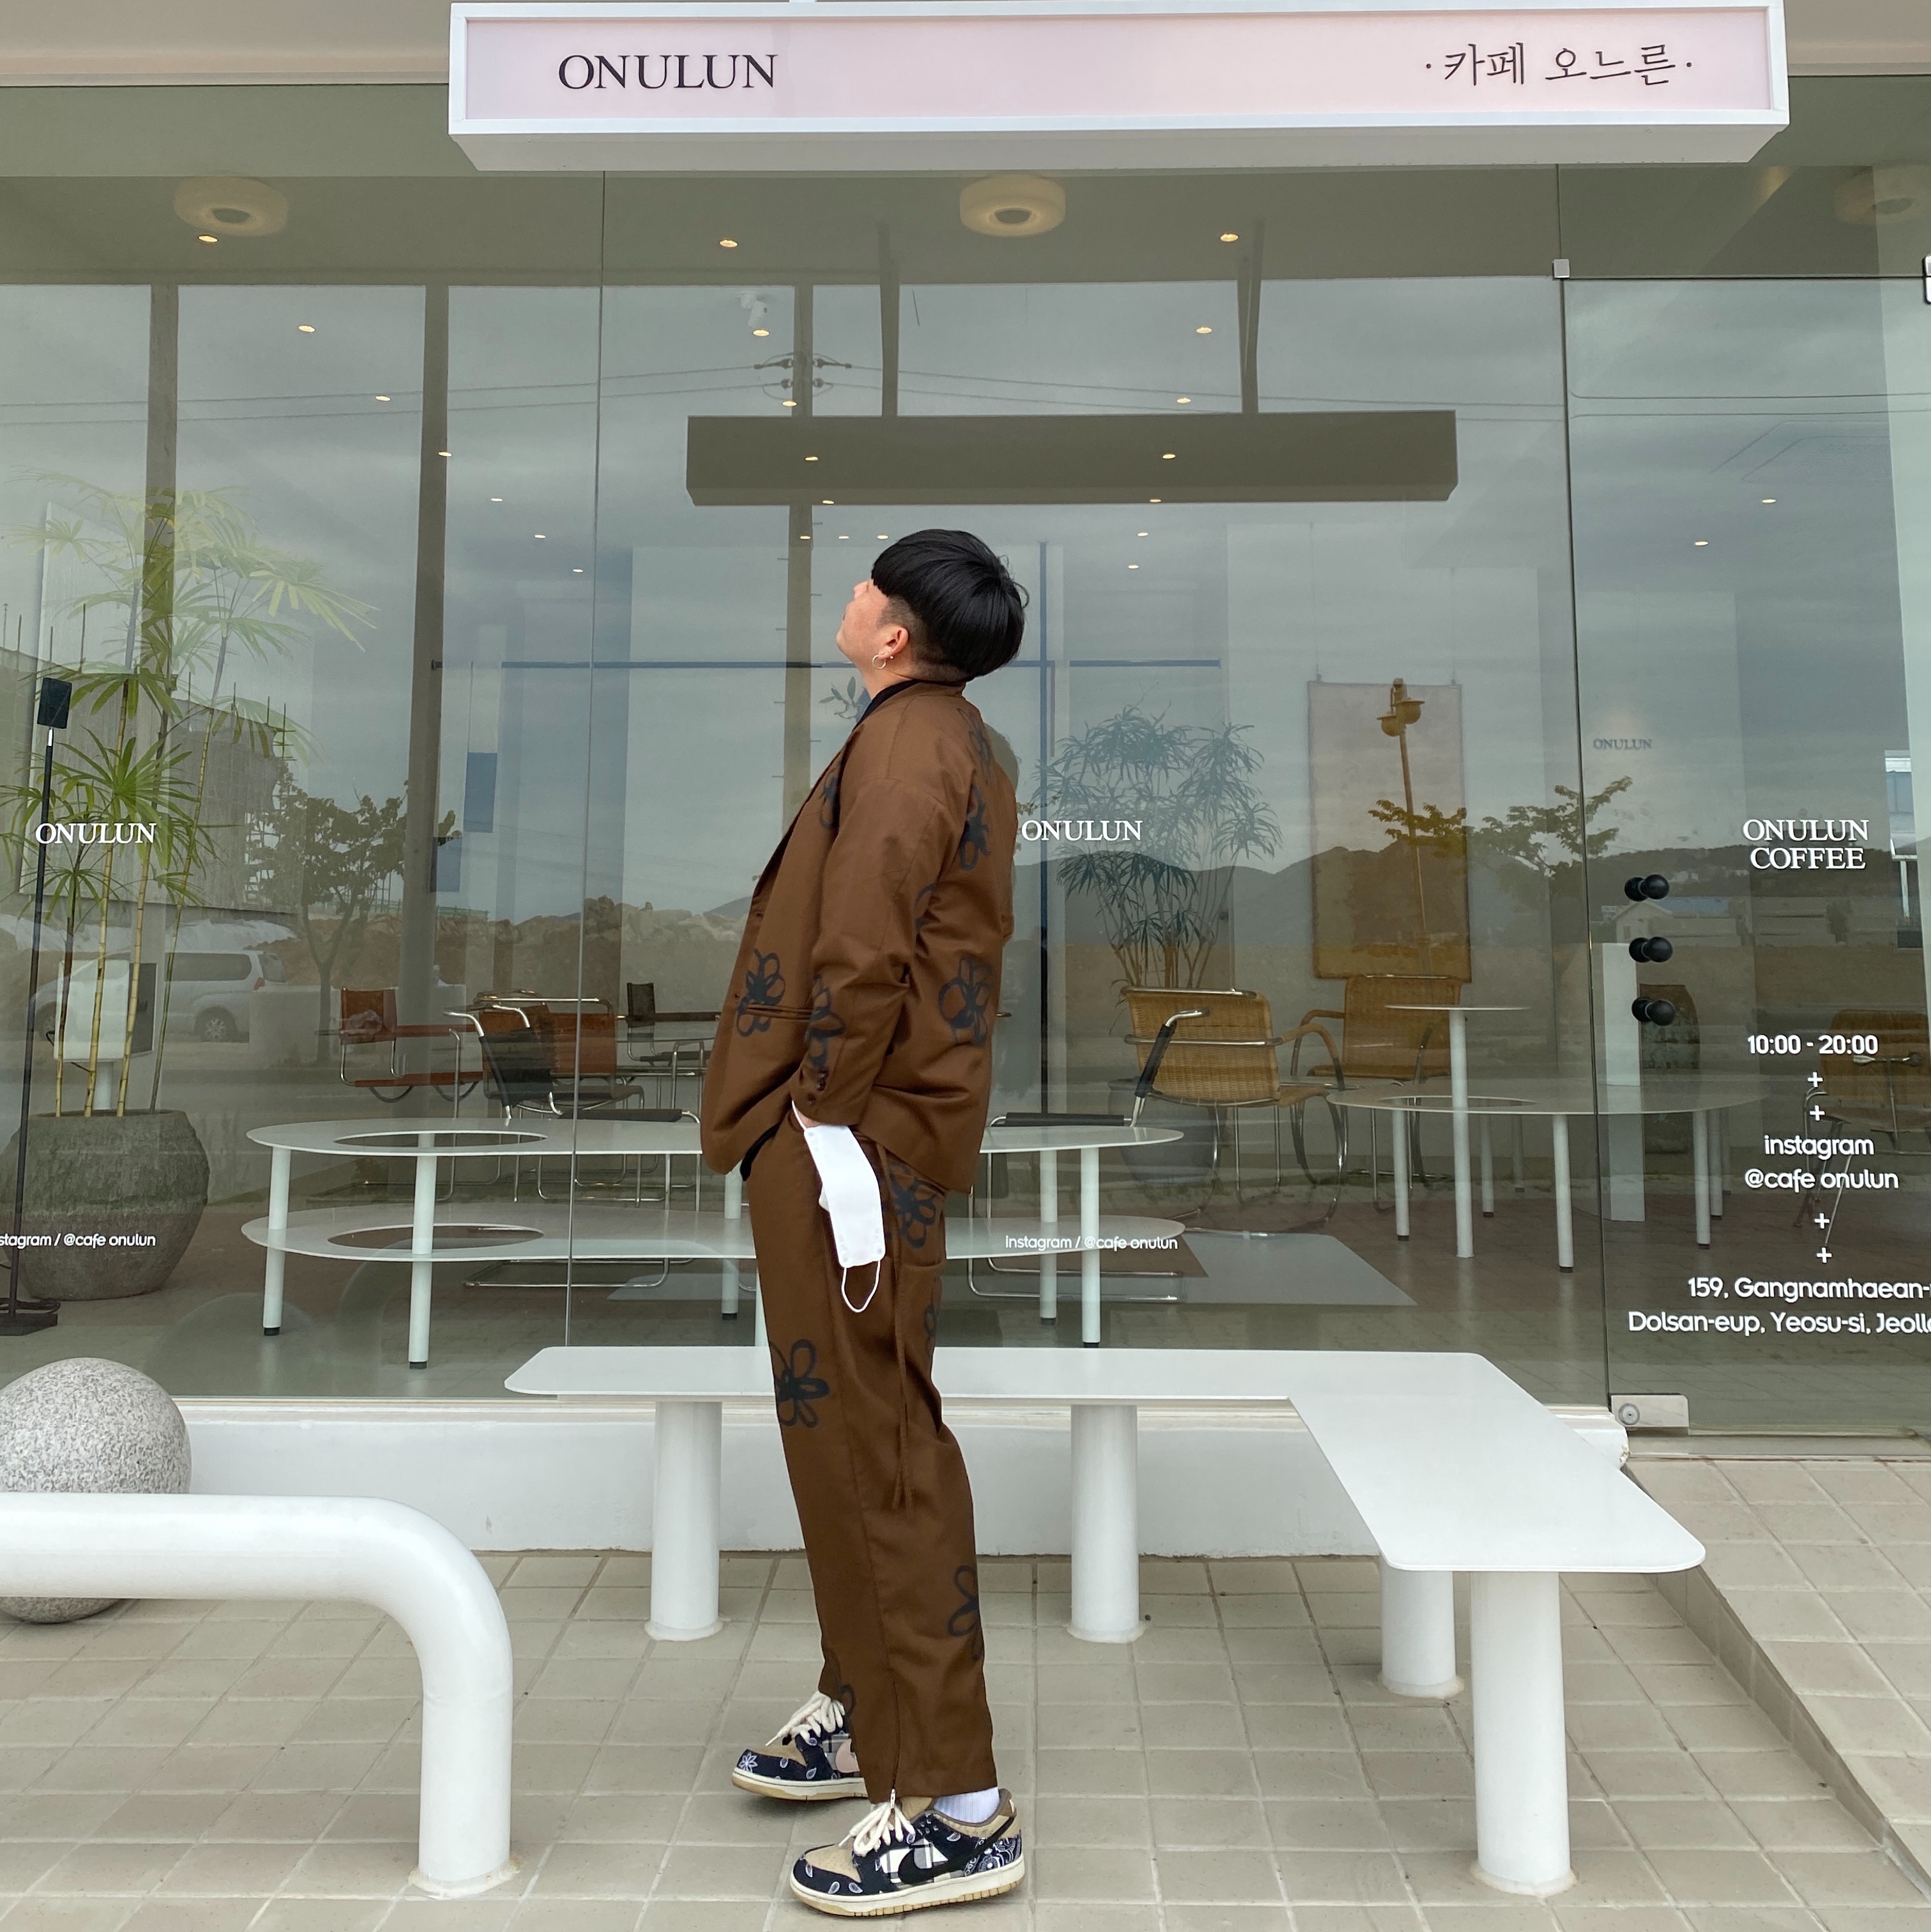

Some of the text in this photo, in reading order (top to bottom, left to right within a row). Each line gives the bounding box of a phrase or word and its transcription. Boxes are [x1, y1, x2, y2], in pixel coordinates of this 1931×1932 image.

[558, 54, 778, 89] ONULUN
[1593, 738, 1653, 750] ONULUN
[35, 823, 157, 844] ONULUN
[1021, 819, 1143, 841] ONULUN
[1743, 819, 1870, 841] ONULUN
[1750, 847, 1866, 869] COFFEE
[1748, 1035, 1801, 1054] 10:00
[1819, 1035, 1878, 1054] 20:00
[1764, 1135, 1874, 1160] instagram
[1745, 1168, 1899, 1192] @cafe onulun
[54, 1233, 61, 1246] /
[63, 1233, 107, 1249] @cafe
[109, 1233, 156, 1246] onulun
[1005, 1235, 1178, 1252] instagram / @cafe onulun
[1688, 1277, 1931, 1303] 159, Gangnamhaean-
[1628, 1311, 1765, 1337] Dolsan-eup,
[1770, 1312, 1871, 1335] Yeosu-si,
